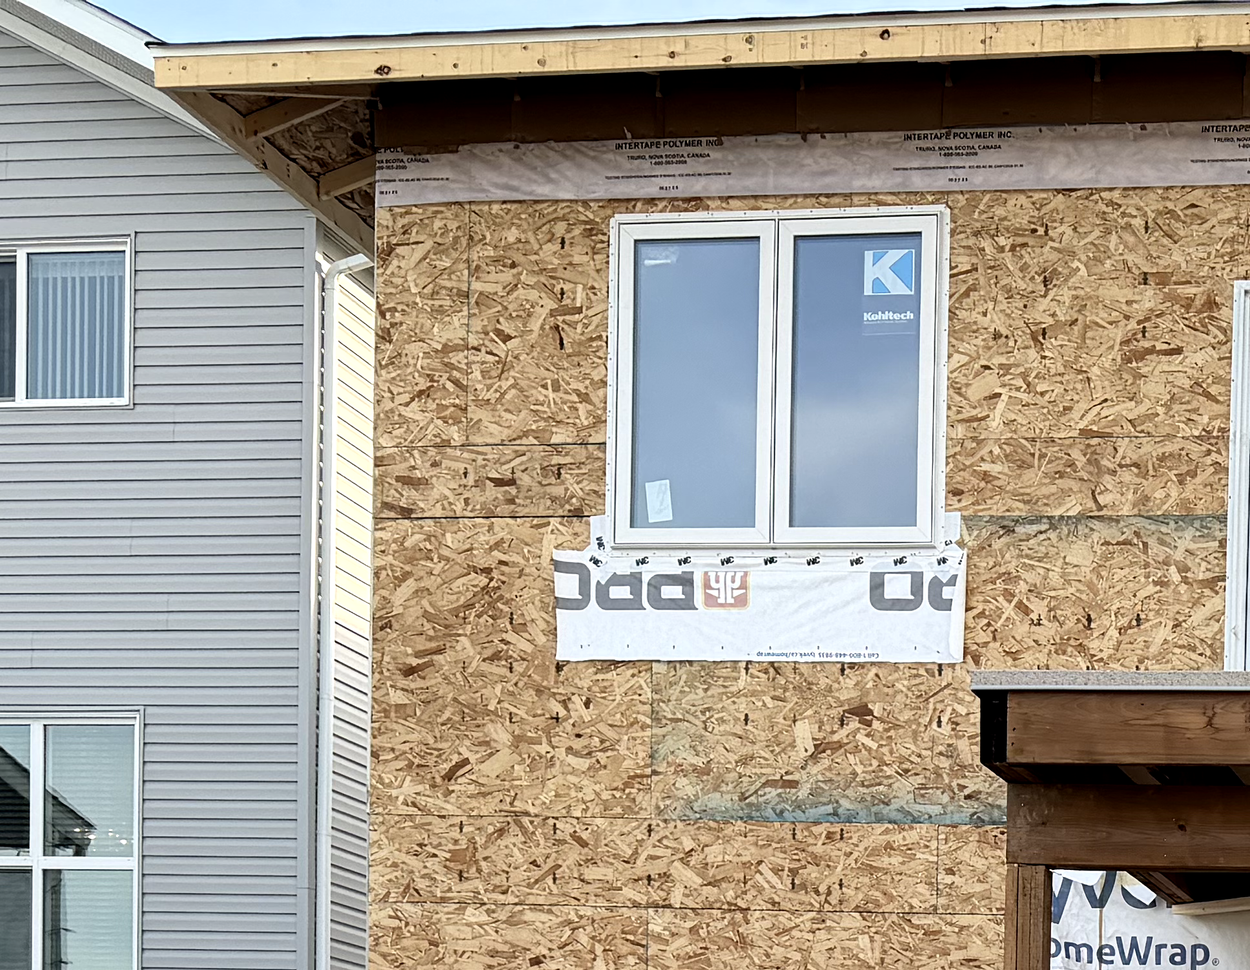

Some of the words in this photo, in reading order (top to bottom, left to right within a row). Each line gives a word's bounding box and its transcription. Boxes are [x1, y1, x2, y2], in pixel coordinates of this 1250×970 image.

[1201, 124, 1250, 133] INTERTAPE
[903, 132, 951, 141] INTERTAPE
[953, 131, 994, 140] POLYMER
[615, 140, 660, 150] INTERTAPE
[663, 139, 702, 148] POLYMER
[863, 310, 914, 322] Kohltech
[635, 556, 650, 567] 3M
[677, 556, 692, 567] 3M
[720, 556, 735, 567] 3M
[763, 556, 778, 566] 3M
[806, 556, 821, 567] 3M
[850, 556, 865, 567] 3M
[893, 555, 908, 567] 3M
